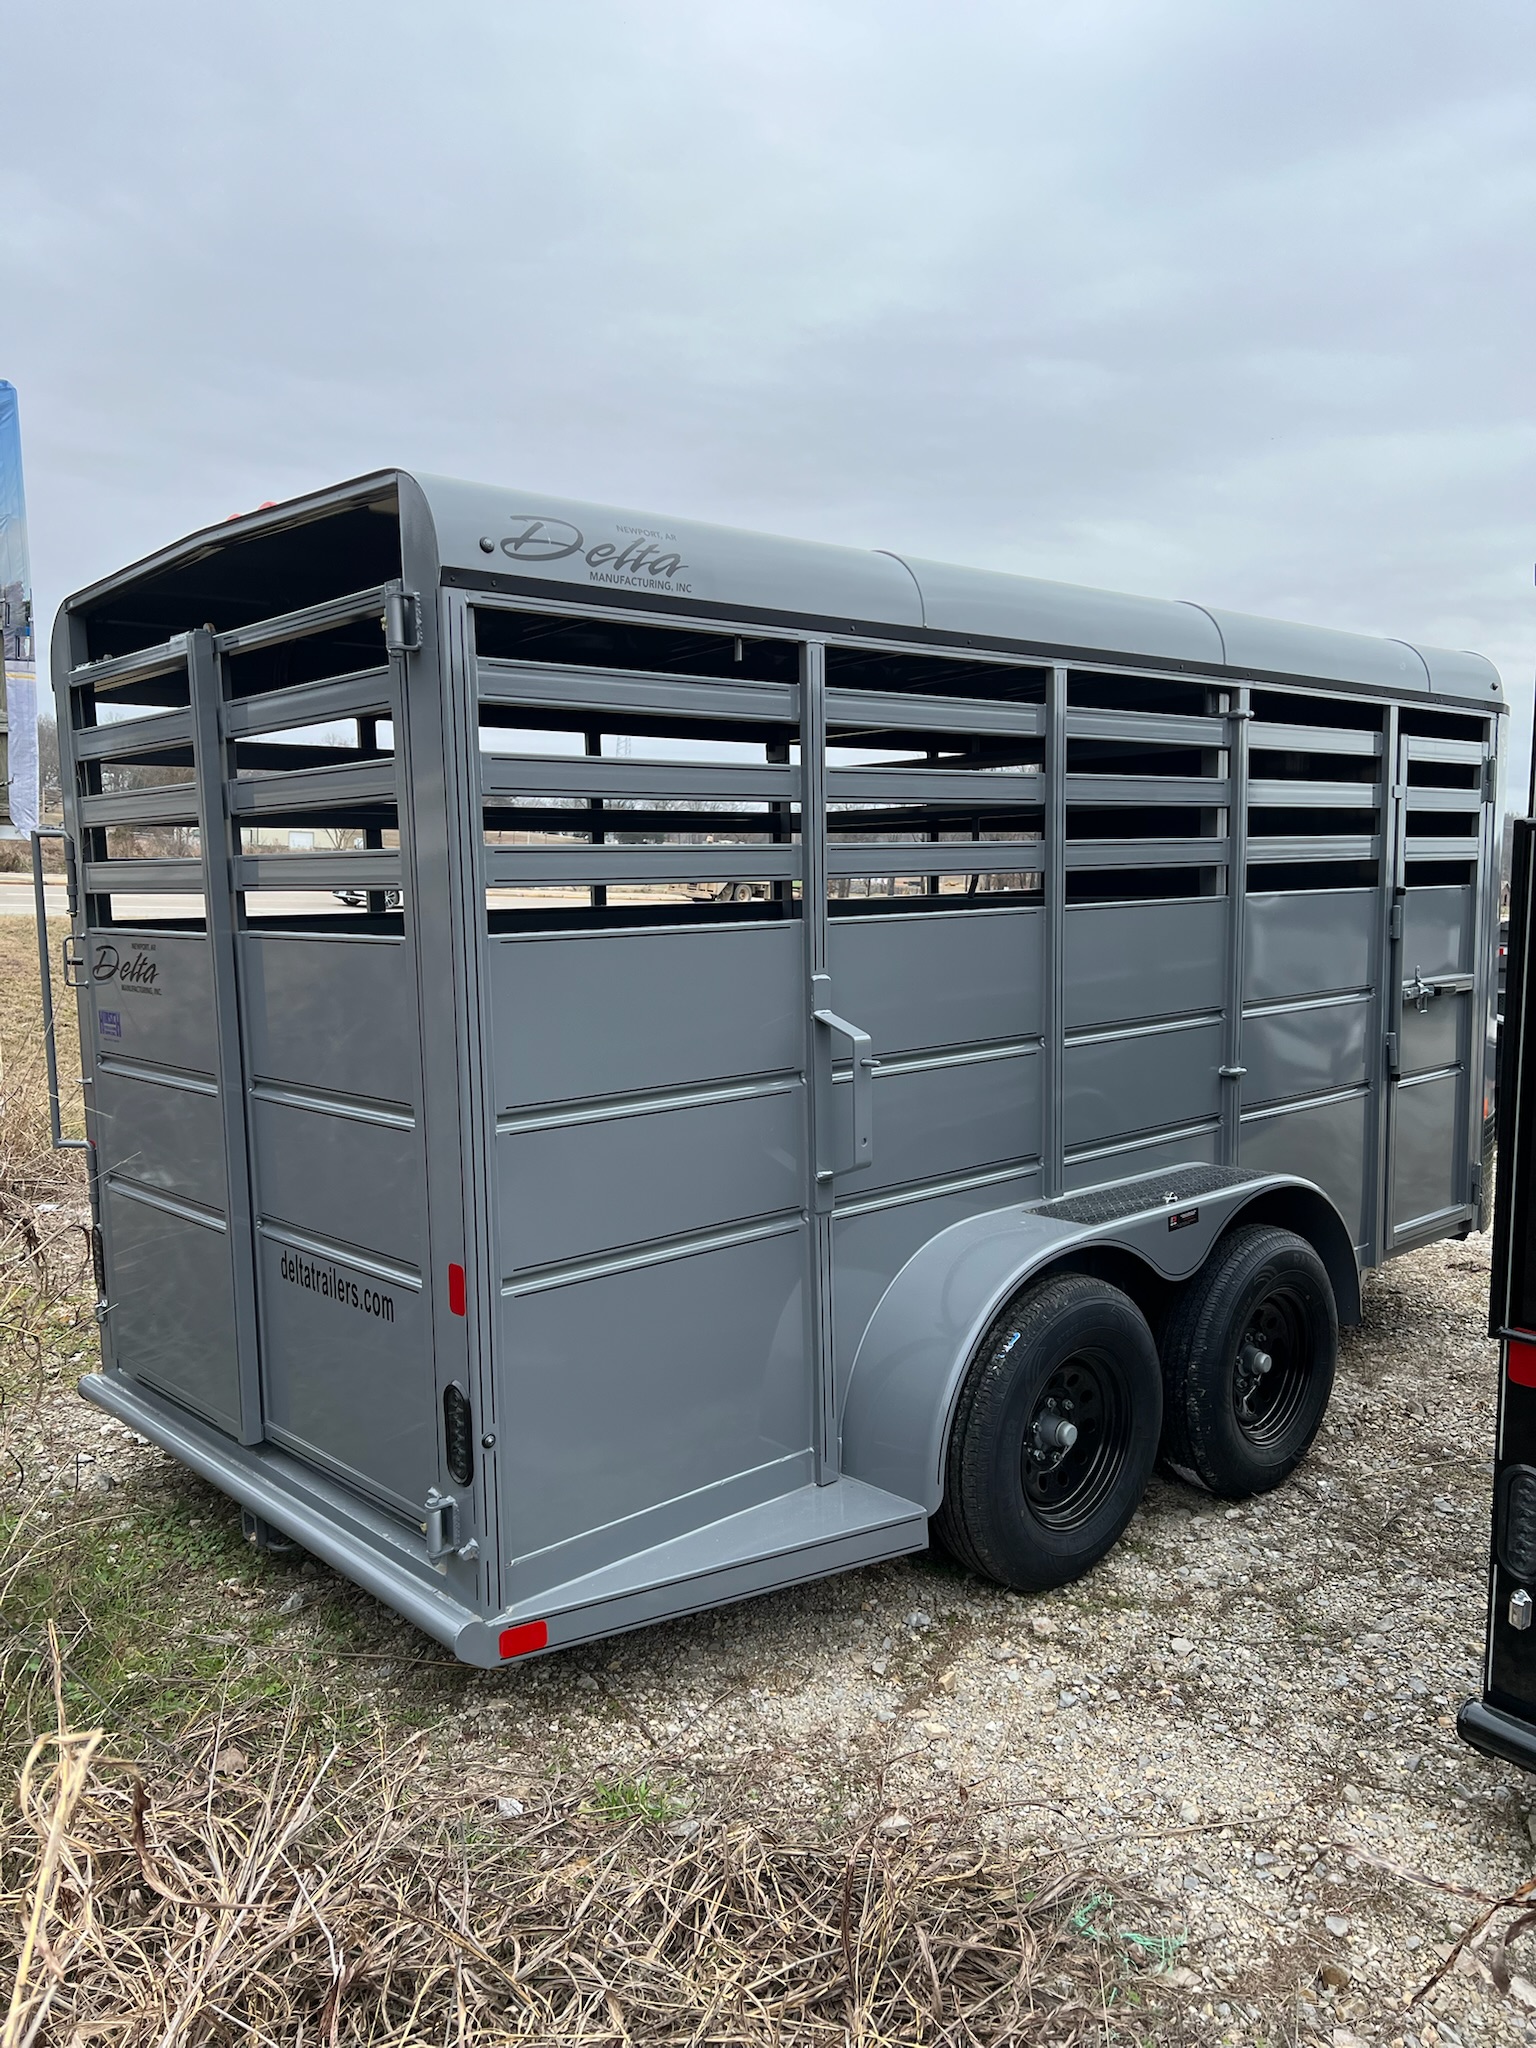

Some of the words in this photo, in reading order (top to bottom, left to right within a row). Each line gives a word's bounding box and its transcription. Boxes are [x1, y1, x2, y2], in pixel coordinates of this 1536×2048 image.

[499, 514, 690, 578] Delta
[615, 524, 663, 541] NEWPORT,
[665, 532, 678, 542] AR
[589, 571, 674, 592] MANUFACTURING,
[92, 945, 160, 984] Delta
[280, 1250, 395, 1323] deltatrailers.com
